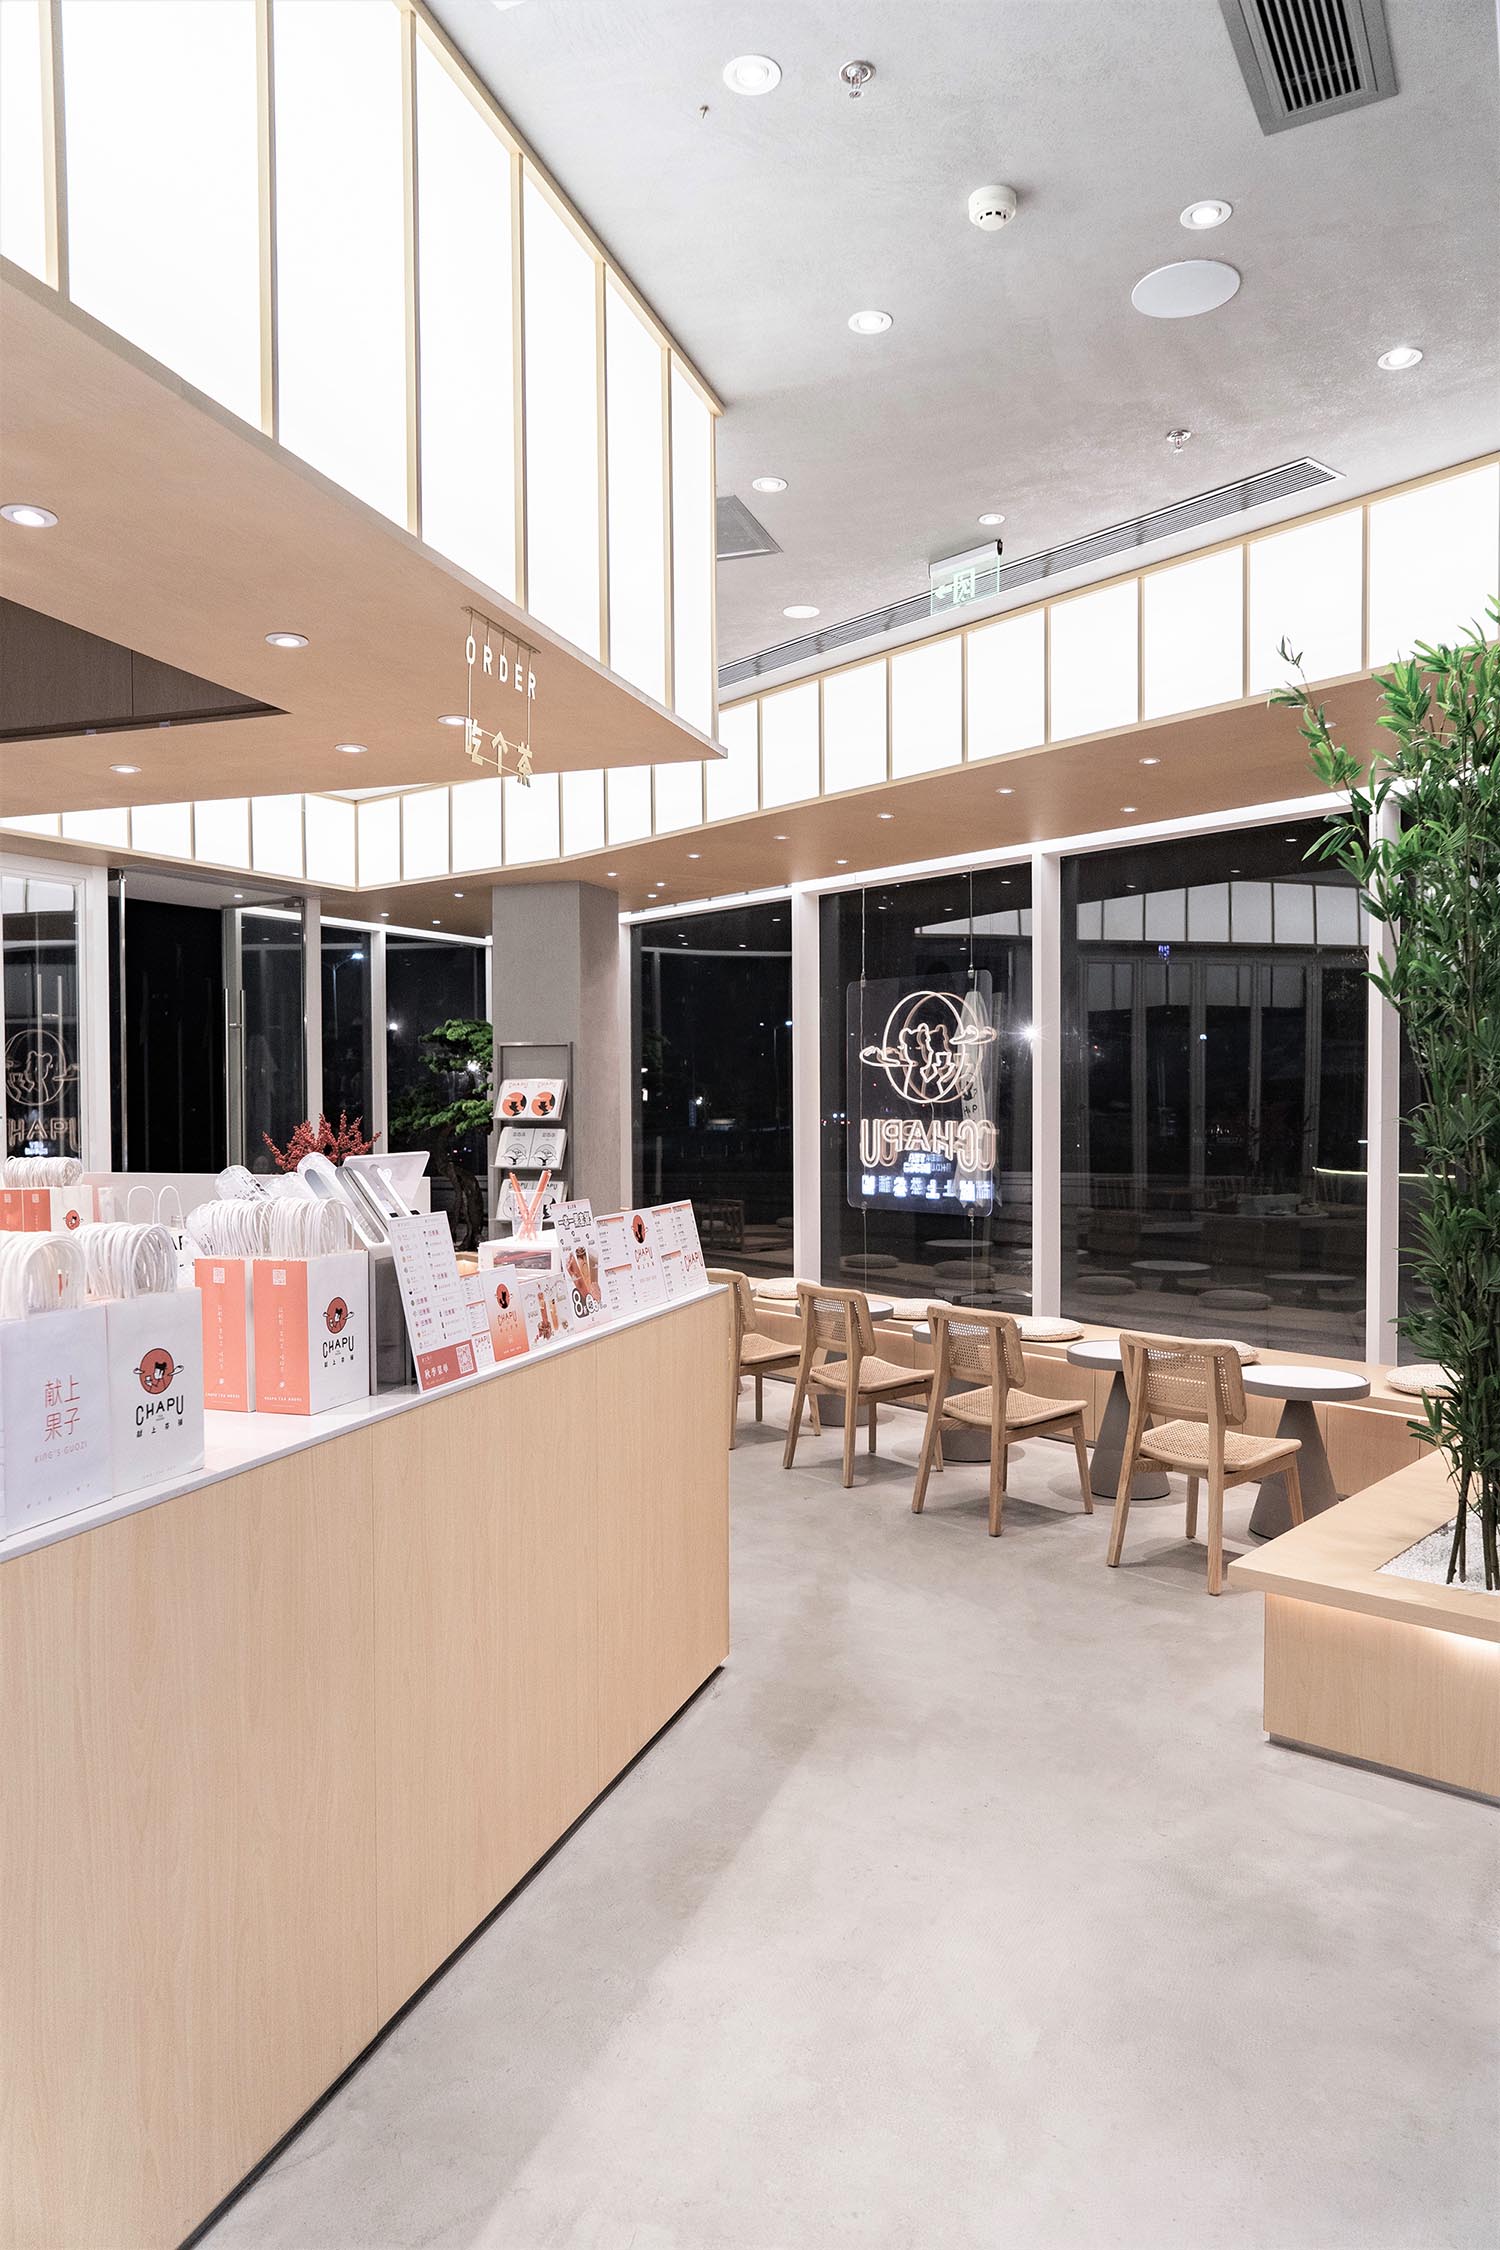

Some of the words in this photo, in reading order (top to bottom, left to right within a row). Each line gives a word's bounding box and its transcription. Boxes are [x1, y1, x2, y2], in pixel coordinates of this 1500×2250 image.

[465, 635, 537, 700] ORDER
[322, 1335, 354, 1358] CHAPU
[45, 1375, 80, 1408] 献上
[45, 1407, 81, 1441] 果子
[135, 1394, 184, 1426] CHAPU
